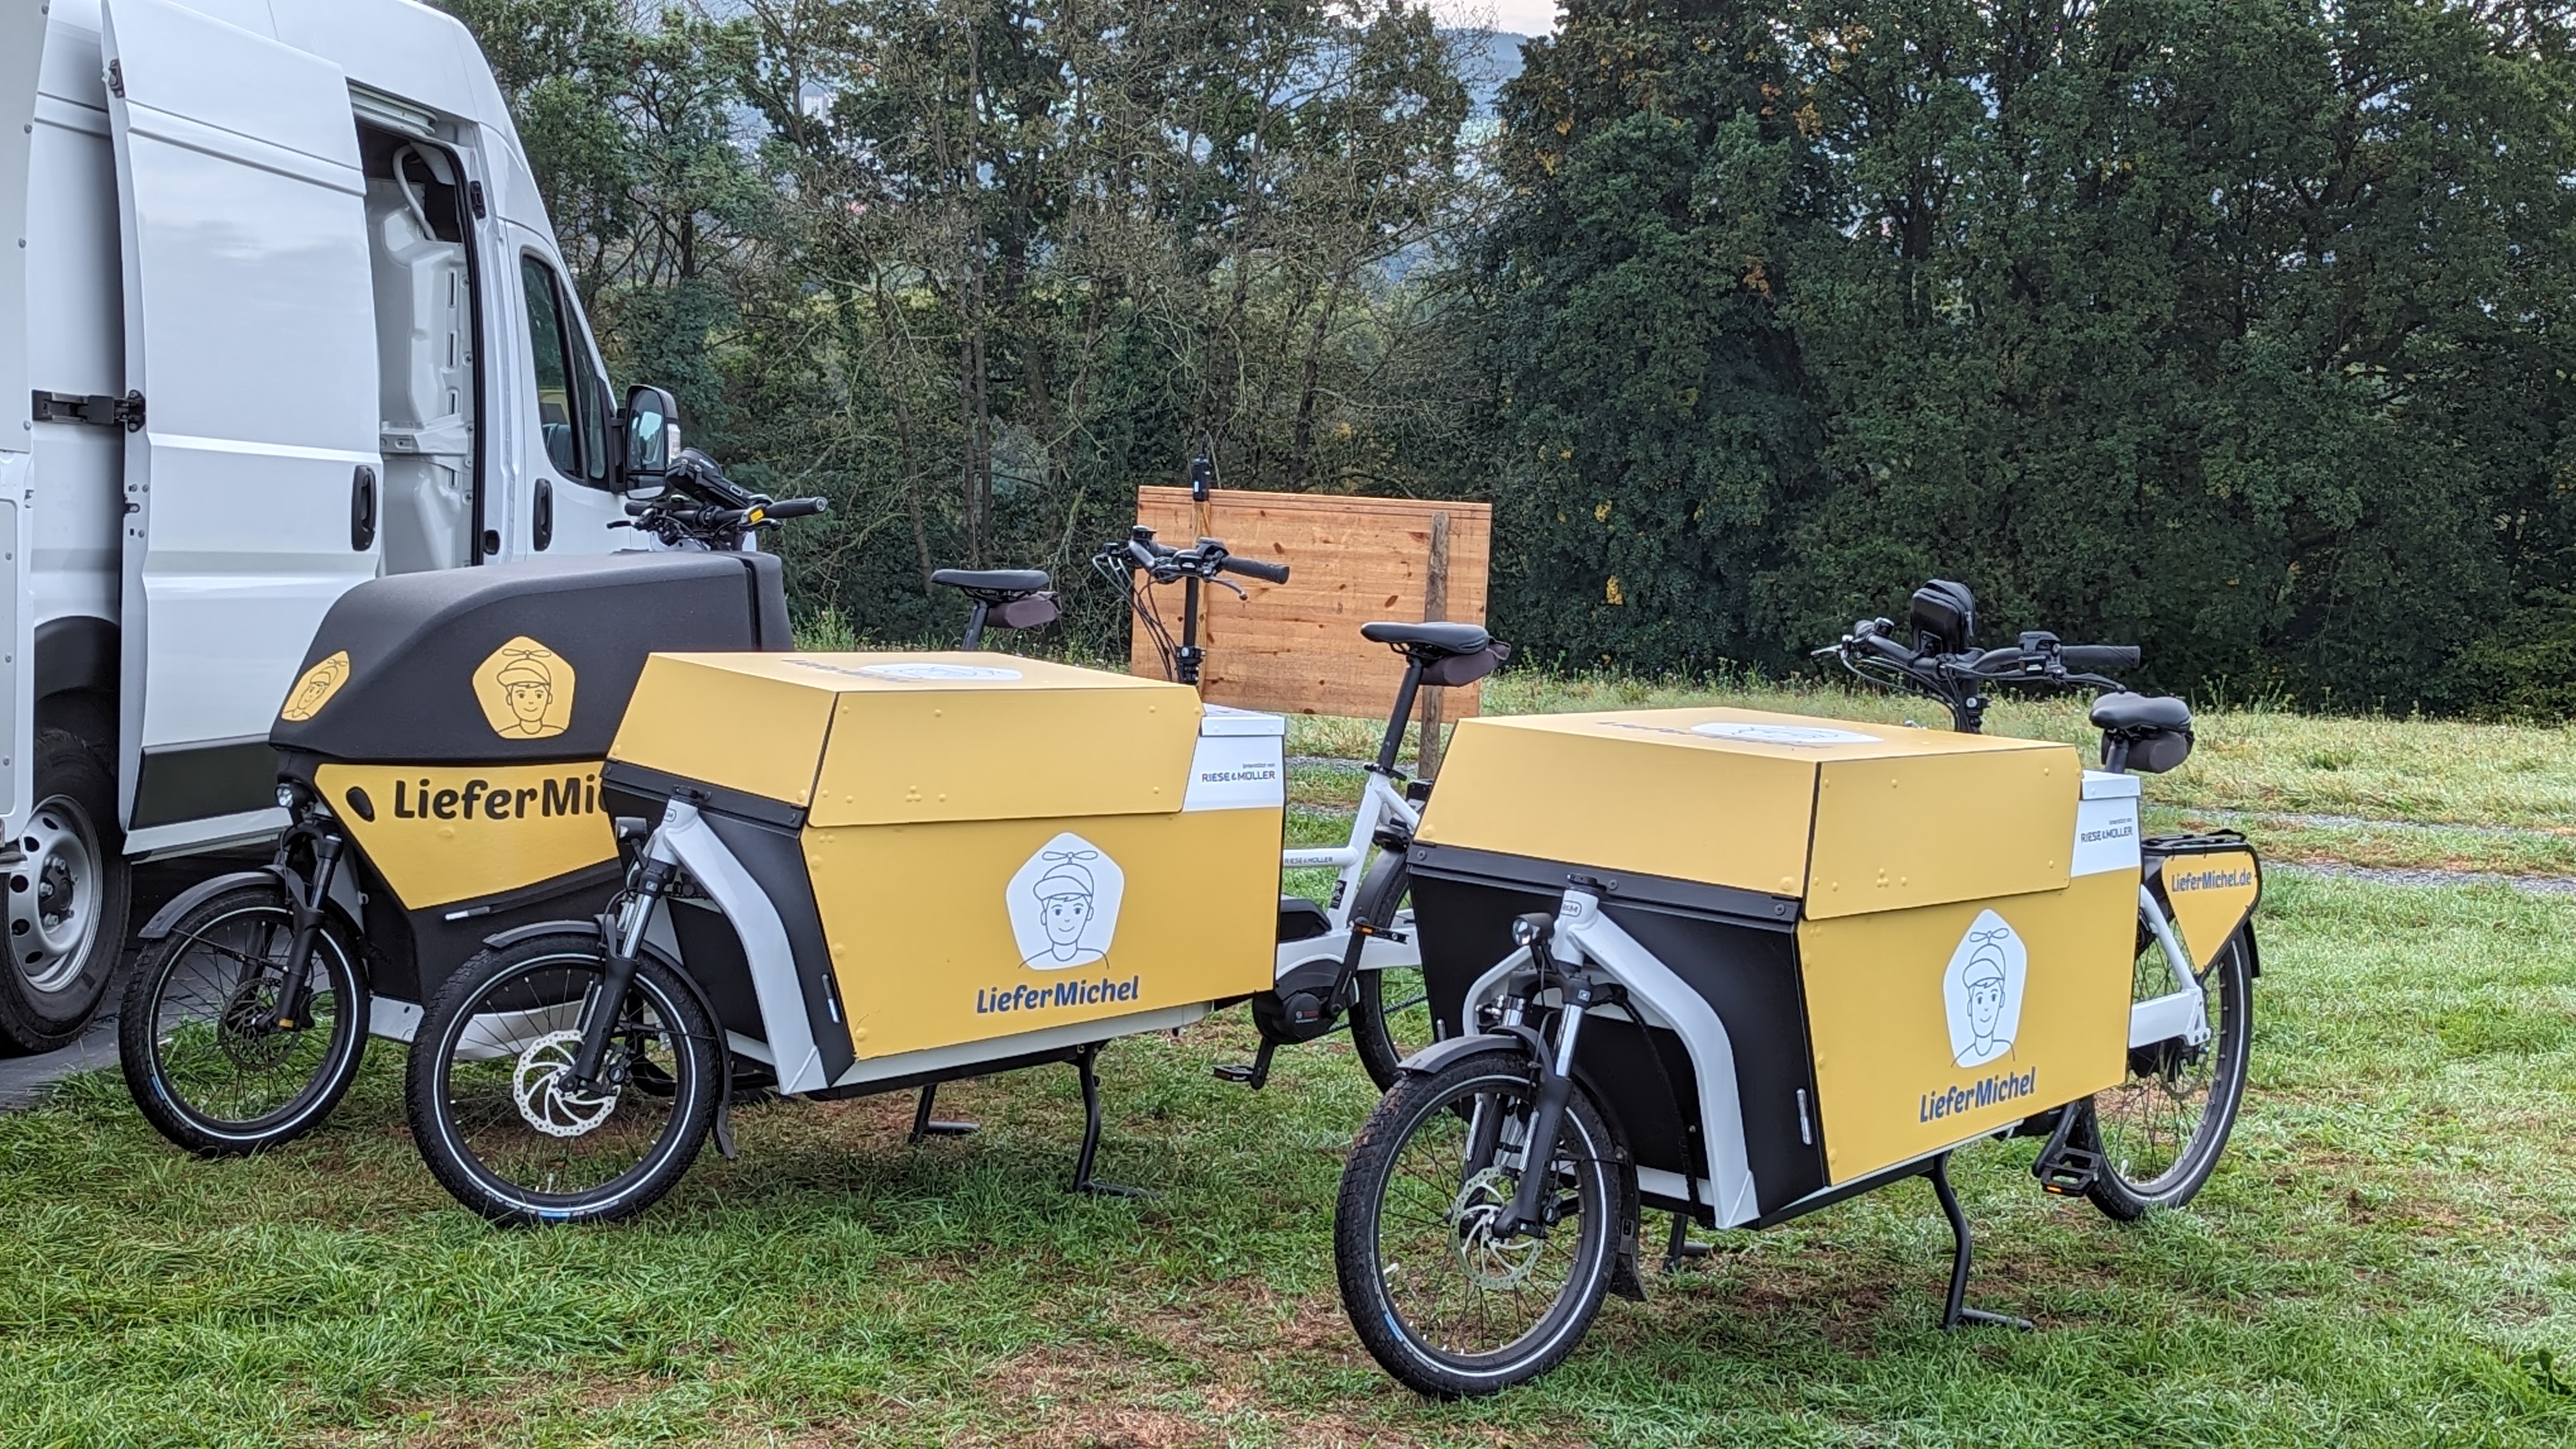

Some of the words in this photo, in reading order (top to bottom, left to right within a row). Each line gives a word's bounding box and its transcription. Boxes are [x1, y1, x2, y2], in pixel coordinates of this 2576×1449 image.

[2171, 868, 2252, 892] LieferMichel.de
[976, 975, 1139, 1014] LieferMichel
[1919, 1066, 2036, 1123] LieferMichel
